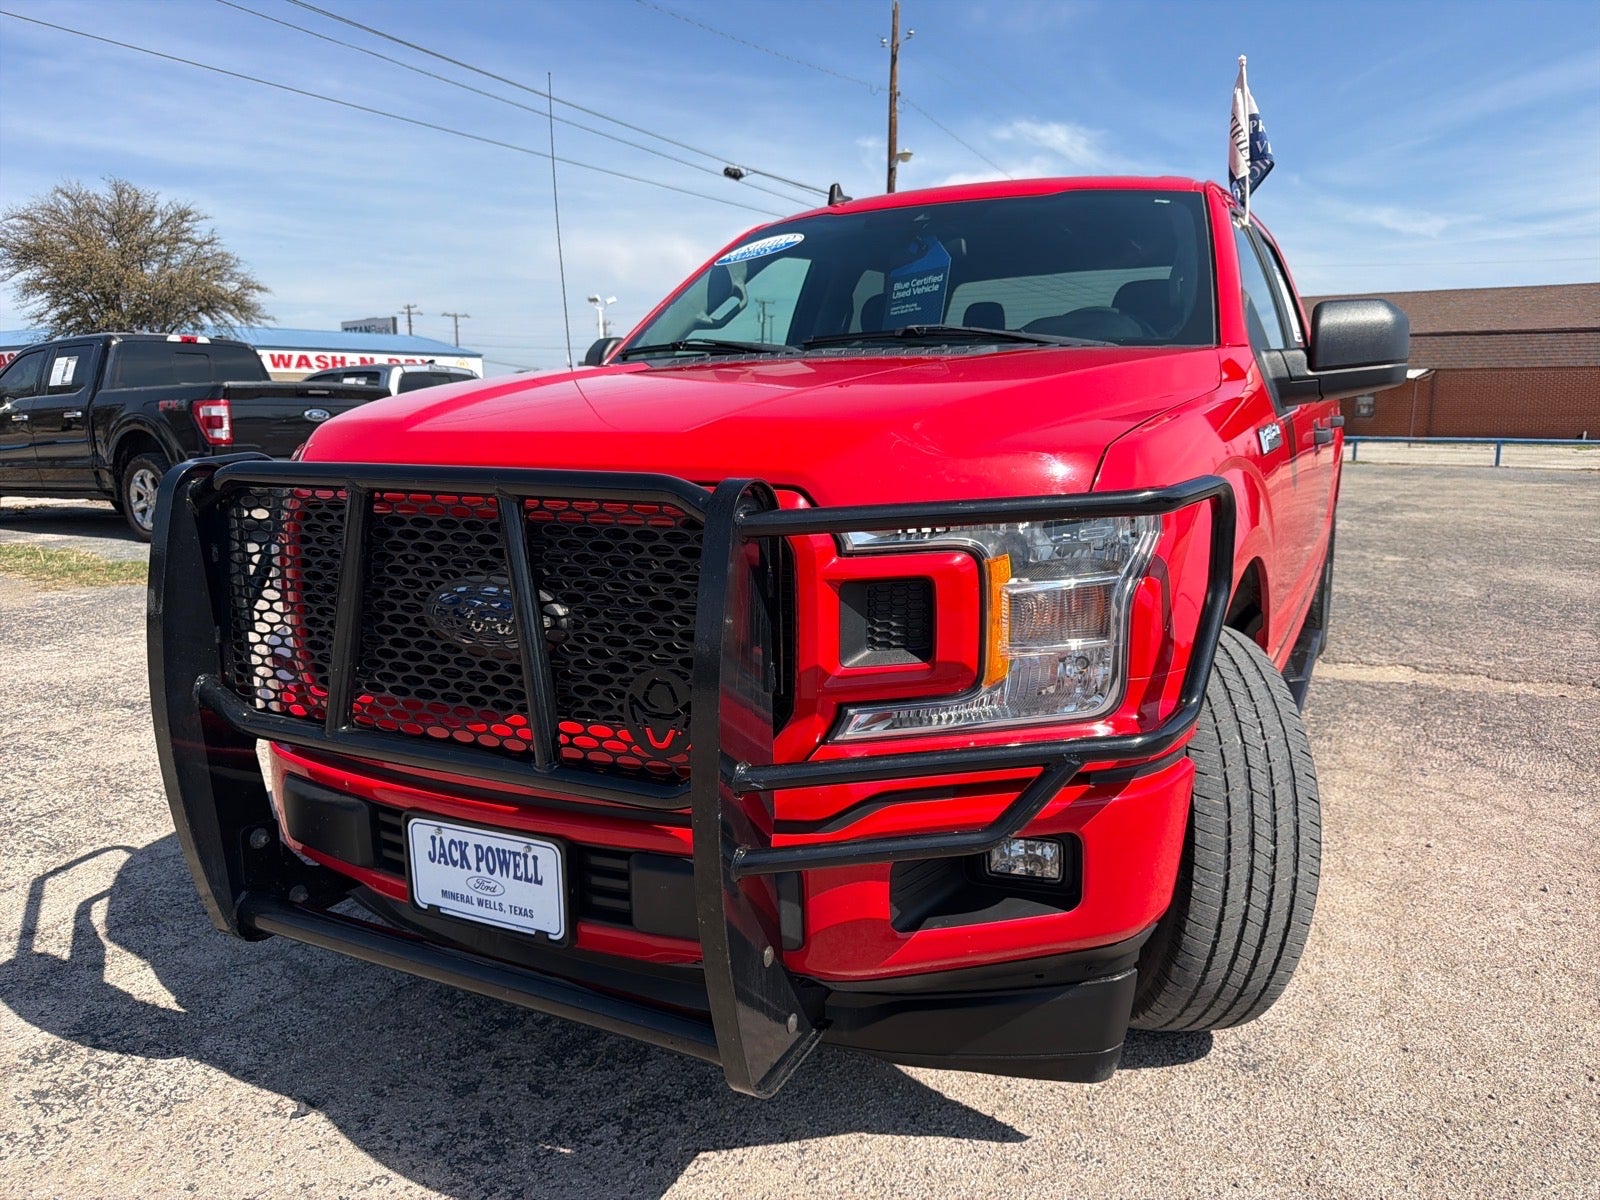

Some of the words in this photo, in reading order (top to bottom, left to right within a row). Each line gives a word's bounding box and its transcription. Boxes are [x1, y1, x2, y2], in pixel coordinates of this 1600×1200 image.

[893, 281, 910, 291] Blue
[911, 273, 944, 287] Certified
[892, 289, 911, 299] Used
[912, 284, 940, 295] Vehicle
[428, 835, 472, 870] JACK
[474, 844, 543, 886] POWELL
[473, 879, 498, 893] Ford
[441, 889, 474, 905] MINERAL
[476, 897, 506, 914] WELLS,
[508, 904, 535, 919] TEXAS
